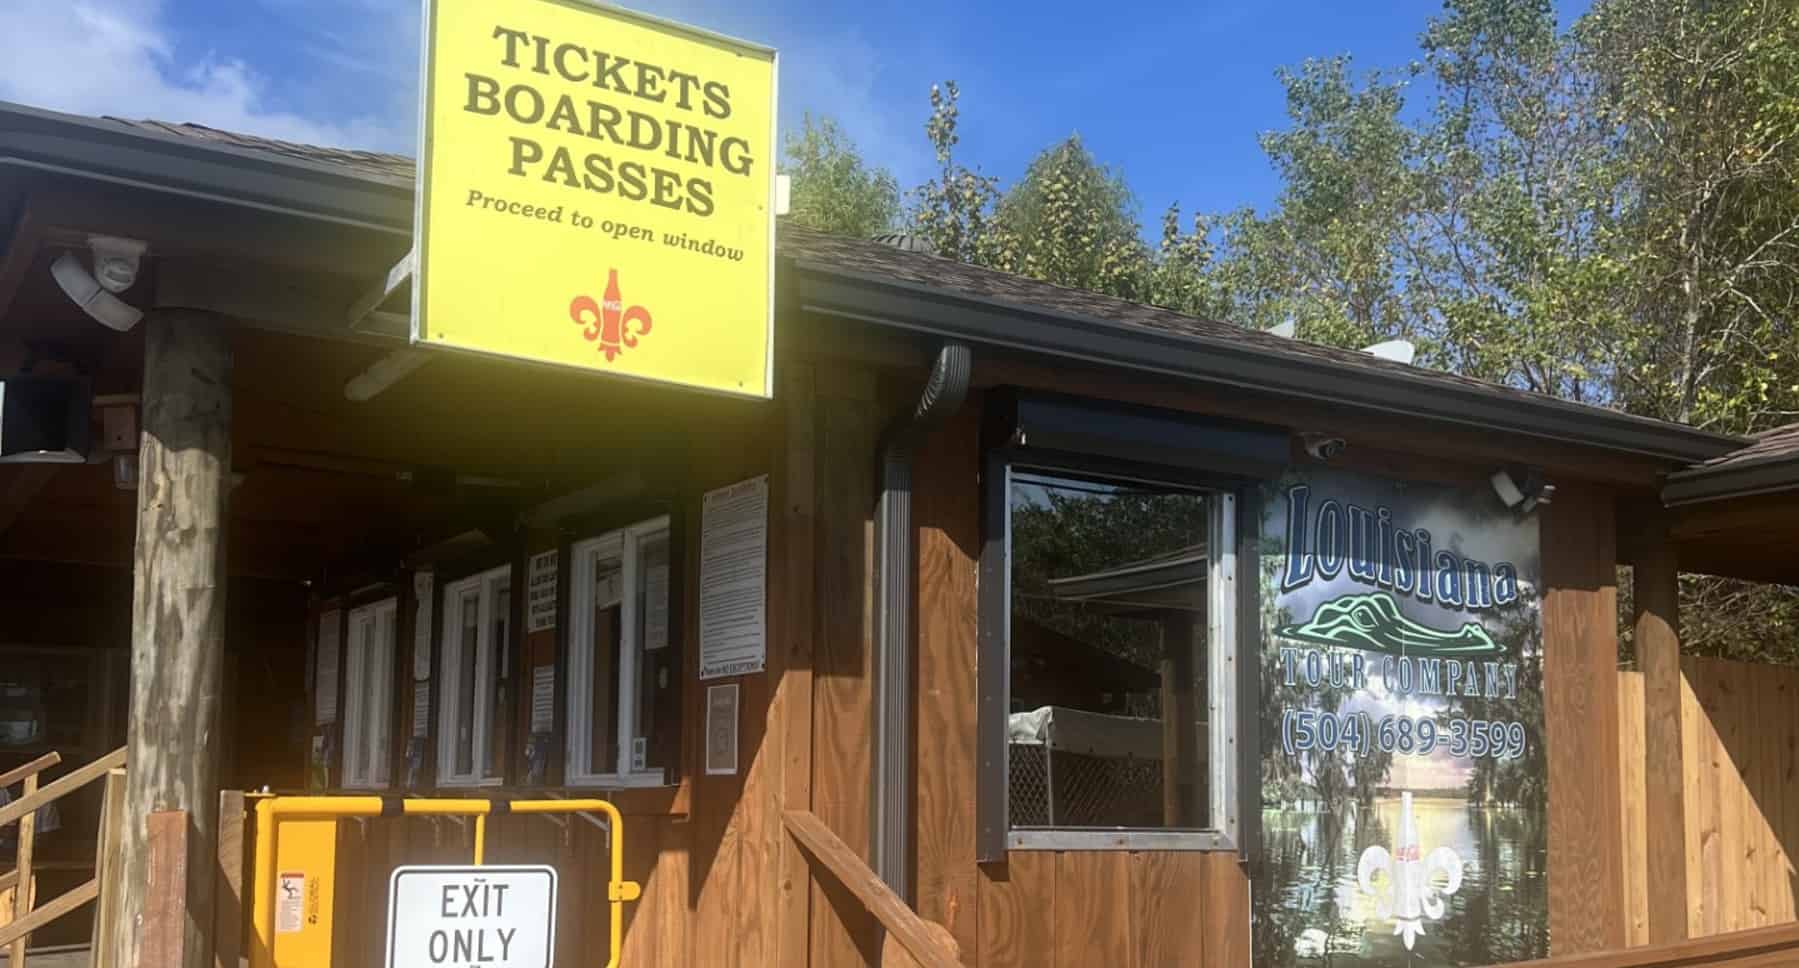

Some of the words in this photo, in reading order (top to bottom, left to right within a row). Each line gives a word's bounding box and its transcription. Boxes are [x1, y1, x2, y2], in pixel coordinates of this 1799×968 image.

[492, 25, 732, 120] TICKETS
[463, 72, 755, 177] BOARDING
[507, 136, 715, 218] PASSES
[465, 189, 563, 224] Proceed
[571, 209, 594, 229] to
[601, 218, 655, 242] open
[663, 233, 745, 262] window
[1281, 484, 1519, 609] Louisiana
[1280, 647, 1368, 689] TOUR
[1382, 655, 1518, 701] COMPANY
[1282, 709, 1371, 758] (504)
[1377, 714, 1526, 760] 689-3599
[441, 884, 509, 917] EXIT
[429, 928, 516, 964] ONLY
